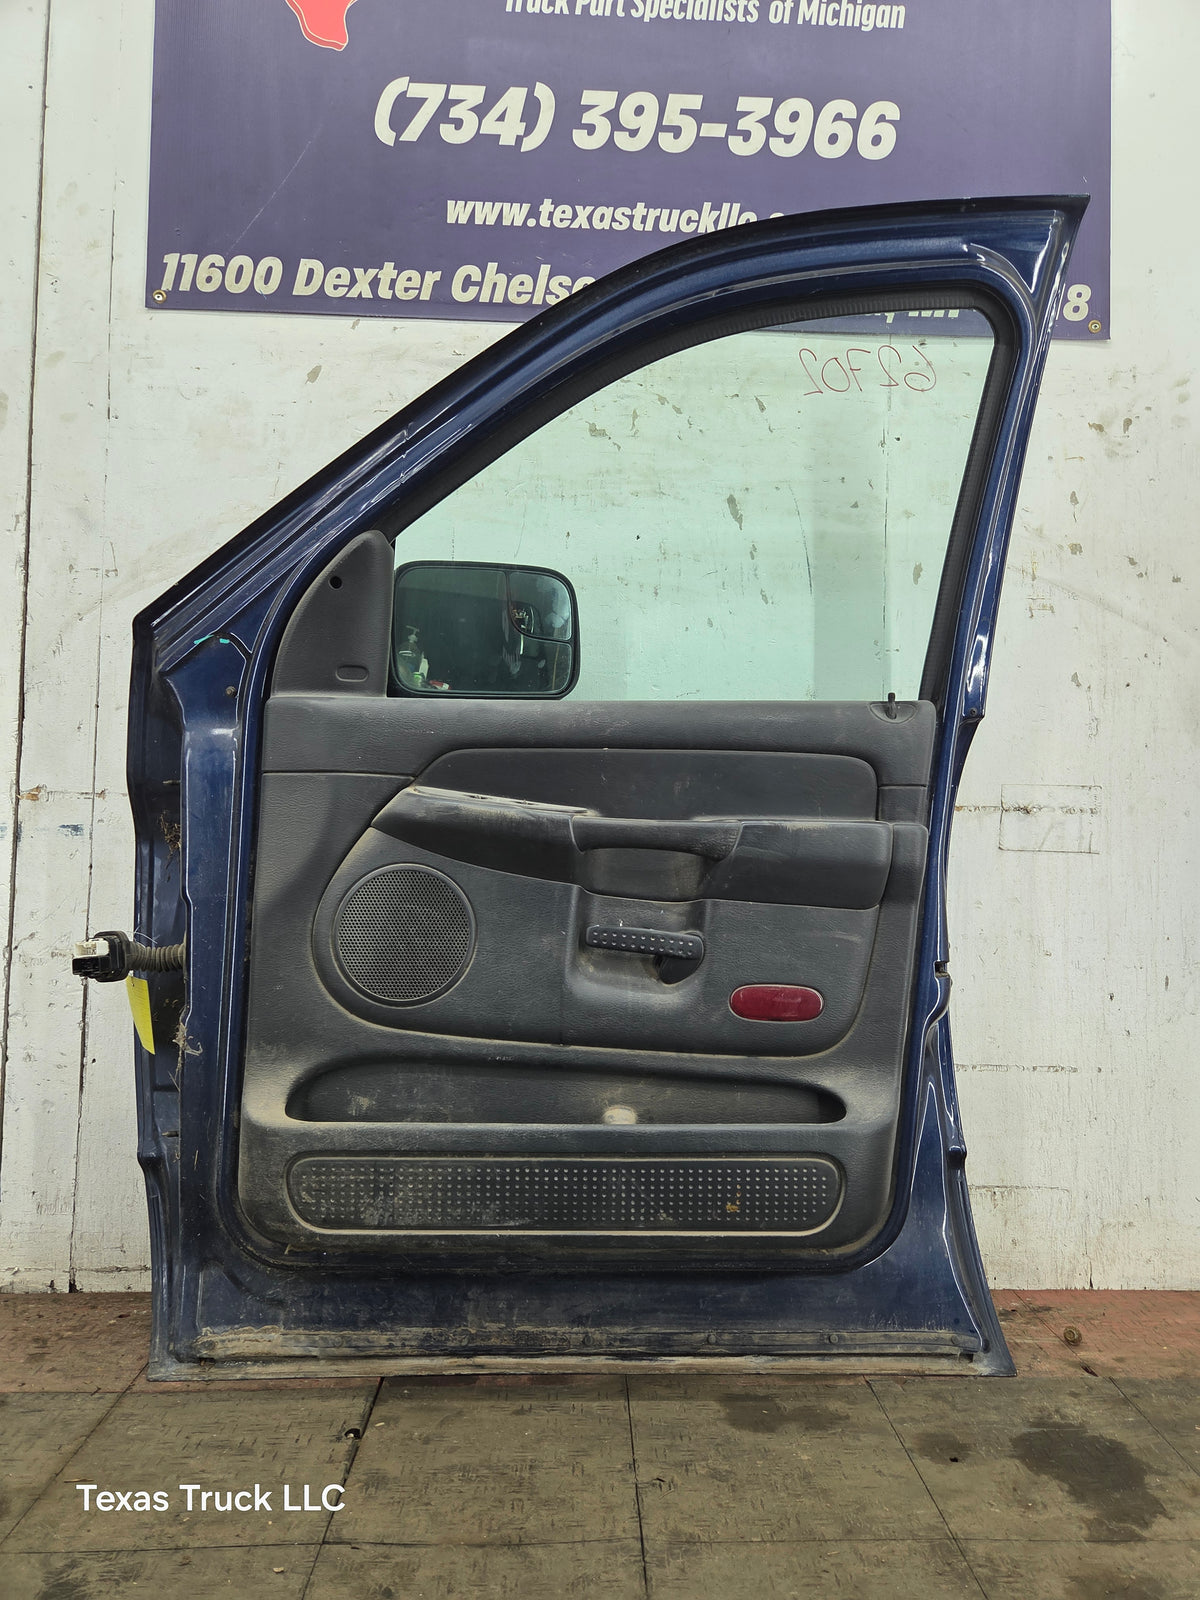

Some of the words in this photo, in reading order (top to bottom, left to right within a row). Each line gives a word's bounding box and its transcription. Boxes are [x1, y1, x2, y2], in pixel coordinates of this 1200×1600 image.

[630, 0, 761, 23] Specialists
[768, 0, 795, 24] of
[797, 0, 906, 32] Michigan
[374, 76, 556, 153] (734)
[572, 89, 901, 161] 395-3966
[161, 252, 283, 295] 11600
[292, 258, 442, 301] Dexter
